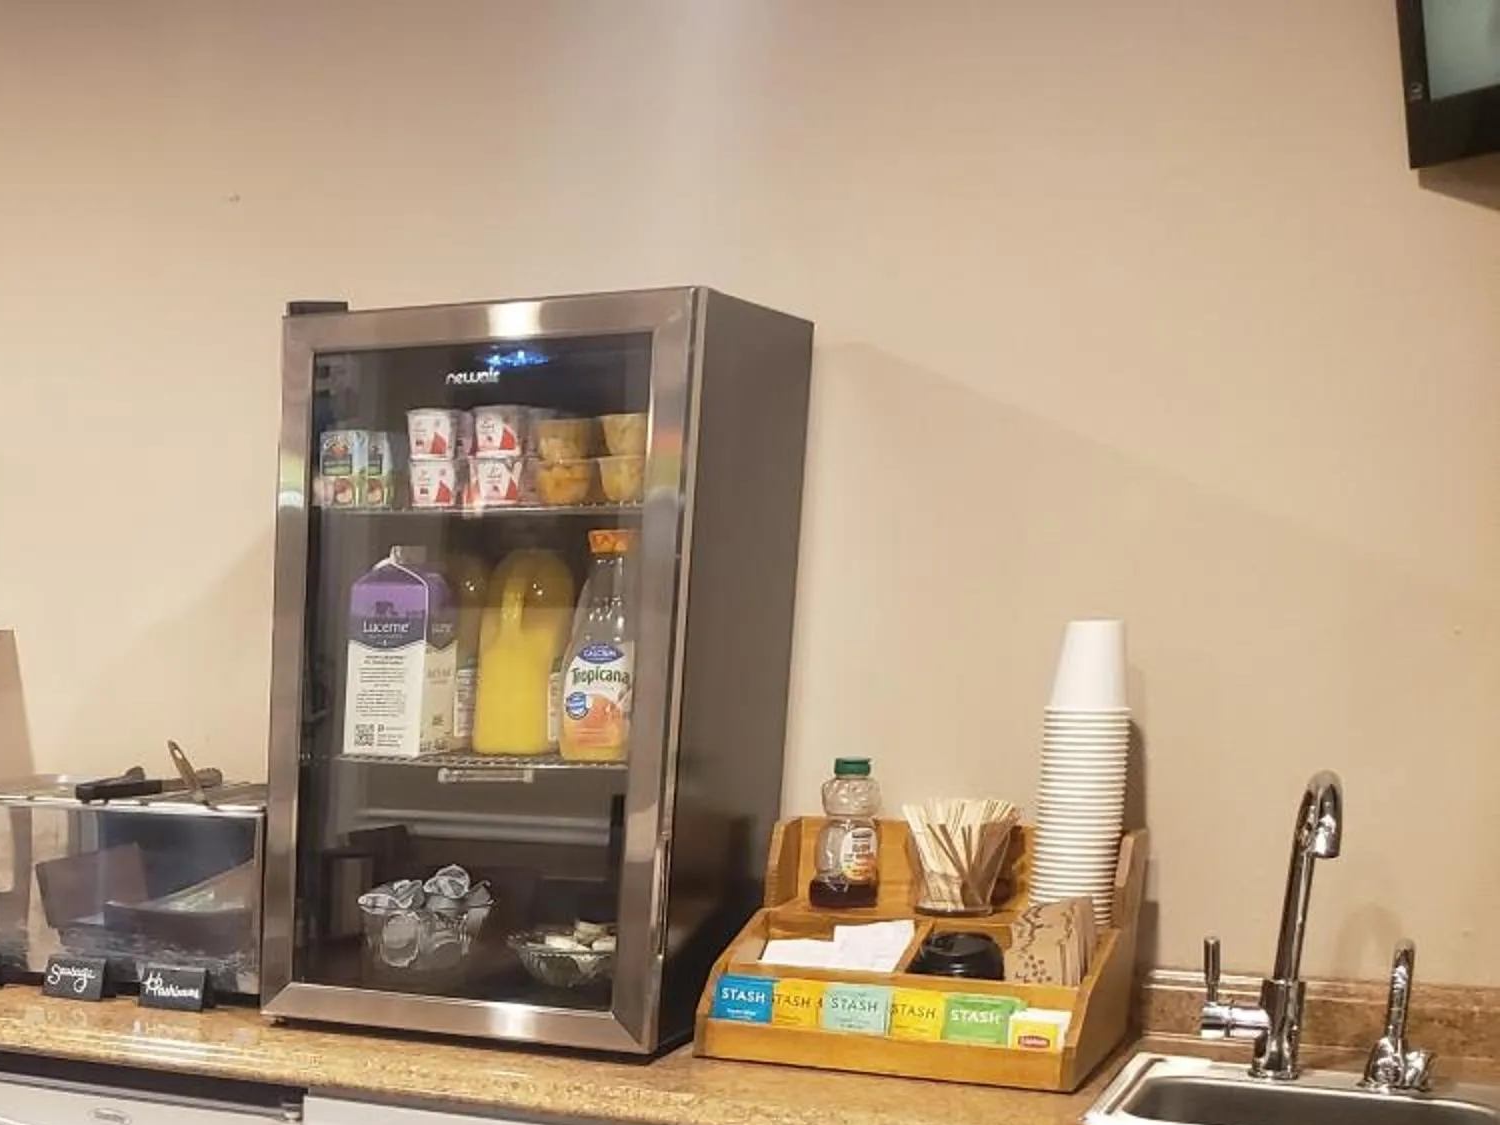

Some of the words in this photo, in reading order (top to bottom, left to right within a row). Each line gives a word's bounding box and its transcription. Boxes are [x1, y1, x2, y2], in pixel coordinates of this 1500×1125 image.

[571, 666, 630, 686] Tropicana
[721, 987, 765, 1004] STASH
[773, 993, 812, 1009] TASH
[831, 997, 878, 1013] STASH
[950, 1009, 1001, 1024] STASH
